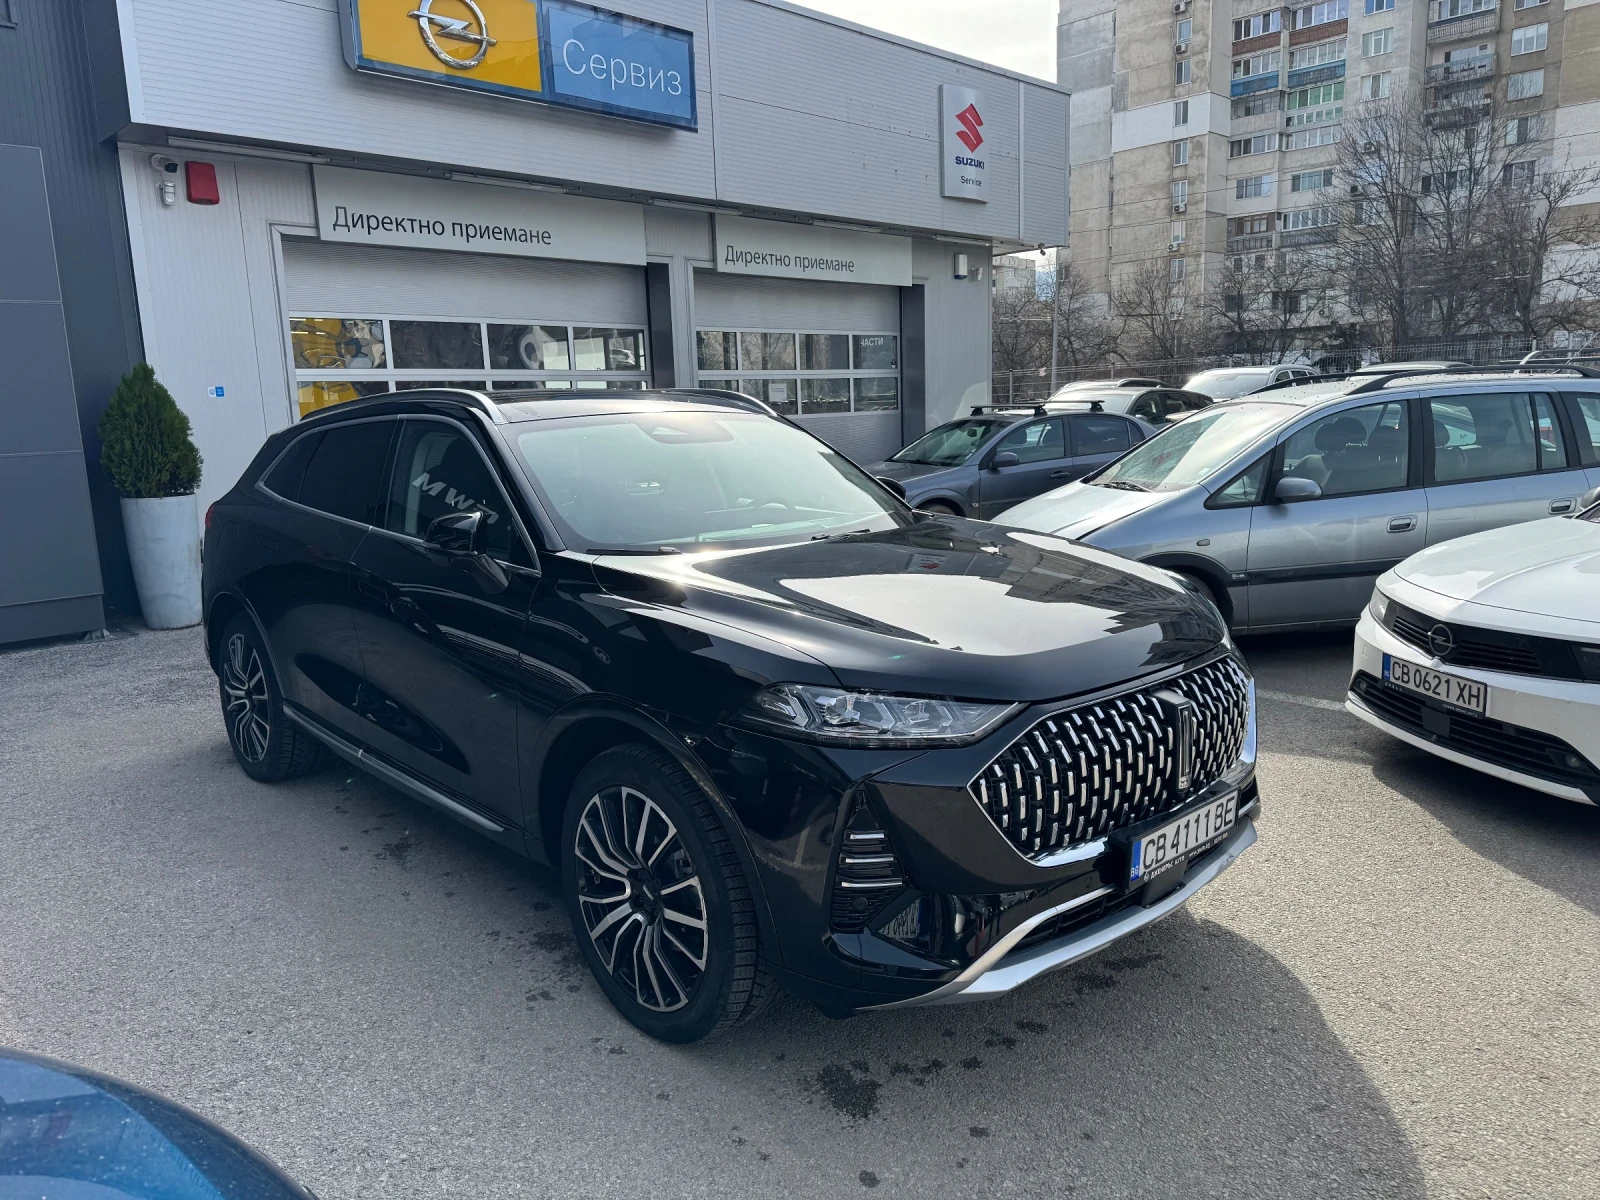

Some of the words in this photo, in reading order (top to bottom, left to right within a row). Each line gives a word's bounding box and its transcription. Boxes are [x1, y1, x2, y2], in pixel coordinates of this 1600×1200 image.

[562, 38, 682, 96] Сервиз
[955, 156, 985, 170] SUZUKI
[960, 175, 982, 187] Service
[332, 205, 446, 236] Директно
[451, 221, 553, 246] приемане
[725, 245, 791, 268] Директно
[794, 256, 855, 273] приемане
[1392, 661, 1410, 684] CB
[1413, 668, 1451, 699] 0621
[1456, 680, 1481, 708] XH
[1131, 865, 1139, 877] BG
[1143, 833, 1167, 870] CB
[1170, 809, 1211, 855] 4111
[1214, 796, 1236, 833] BE
